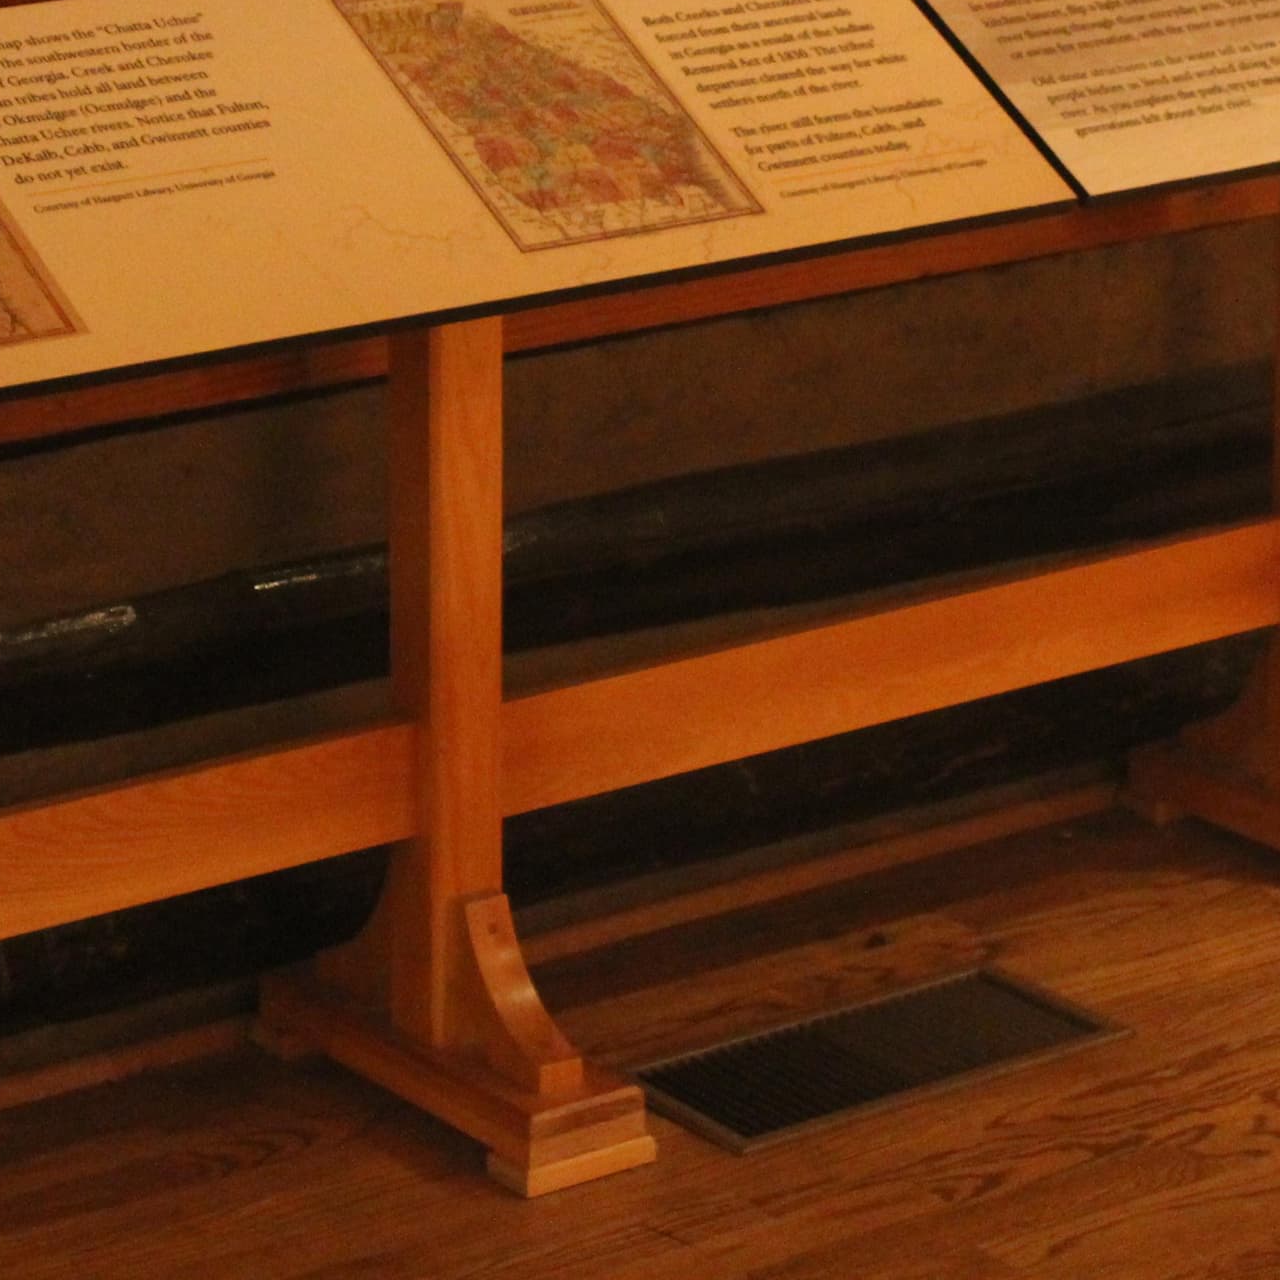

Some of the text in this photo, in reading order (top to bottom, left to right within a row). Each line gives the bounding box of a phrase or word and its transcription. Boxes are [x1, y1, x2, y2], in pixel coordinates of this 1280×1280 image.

[0, 58, 24, 69] the
[25, 45, 120, 64] southwestern
[120, 37, 170, 51] border
[172, 33, 188, 44] of
[189, 31, 213, 42] the
[24, 33, 70, 46] shows
[70, 29, 95, 40] the
[6, 71, 69, 86] Georgia.
[70, 63, 115, 77] Creek
[116, 58, 145, 71] and
[145, 51, 213, 67] Cherokee
[13, 92, 57, 105] tribes
[56, 84, 93, 99] hold
[94, 81, 113, 93] all
[112, 77, 147, 91] land
[146, 71, 208, 86] between
[79, 95, 162, 116] (Ocmulgee)
[164, 89, 192, 103] and
[192, 88, 216, 98] the
[38, 127, 88, 140] Uchee
[89, 120, 134, 133] rivers.
[134, 112, 185, 126] Notice
[186, 107, 216, 119] that
[215, 101, 269, 114] Fulton,
[0, 119, 270, 166] DeKalb, Cobb, and Gwinnett counties
[13, 160, 128, 184] do not yet exist.
